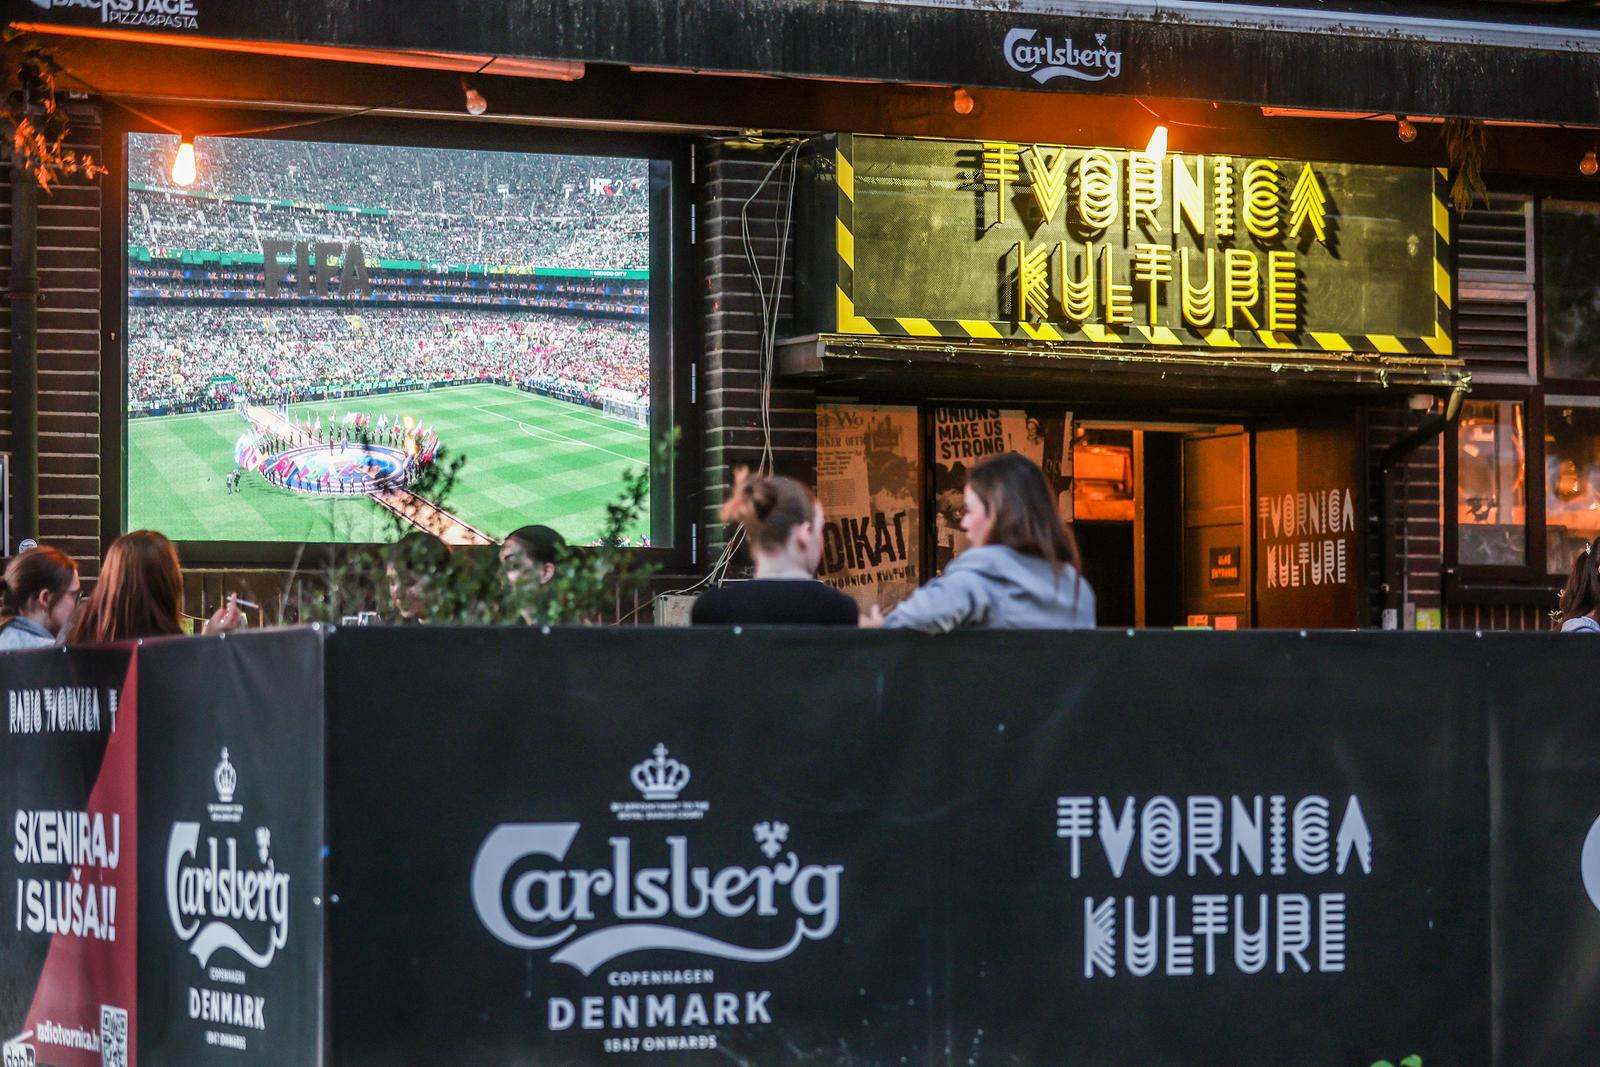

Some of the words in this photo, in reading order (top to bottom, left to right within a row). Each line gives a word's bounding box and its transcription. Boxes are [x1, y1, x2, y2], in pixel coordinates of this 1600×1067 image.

[109, 11, 199, 29] PIZZA&PASTA
[1003, 28, 1122, 84] Carlsberg
[982, 142, 1326, 242] TVORNICA
[263, 240, 371, 297] FIFA
[1018, 239, 1297, 332] KULTURE
[938, 423, 980, 441] MAKE
[984, 420, 1003, 437] US
[941, 437, 1005, 460] STRONG
[1259, 488, 1355, 539] TVORNICA
[1267, 539, 1347, 588] KULTURE
[9, 689, 42, 734] RADIO
[44, 686, 101, 733] TVORNICA
[15, 809, 120, 869] SKENIRAJ
[1056, 795, 1373, 879] TVORNICA
[17, 878, 25, 932] I
[26, 867, 117, 942] SLUŠAJ!
[165, 821, 290, 969] Carlsberg
[472, 822, 844, 976] Carlsberg
[1083, 893, 1346, 979] KULTURE
[608, 969, 714, 986] COPENHAGEN
[189, 986, 267, 1031] DENMARK
[549, 991, 772, 1031] DENMARK
[604, 1038, 639, 1053] 1847
[641, 1034, 717, 1051] ONWARDS
